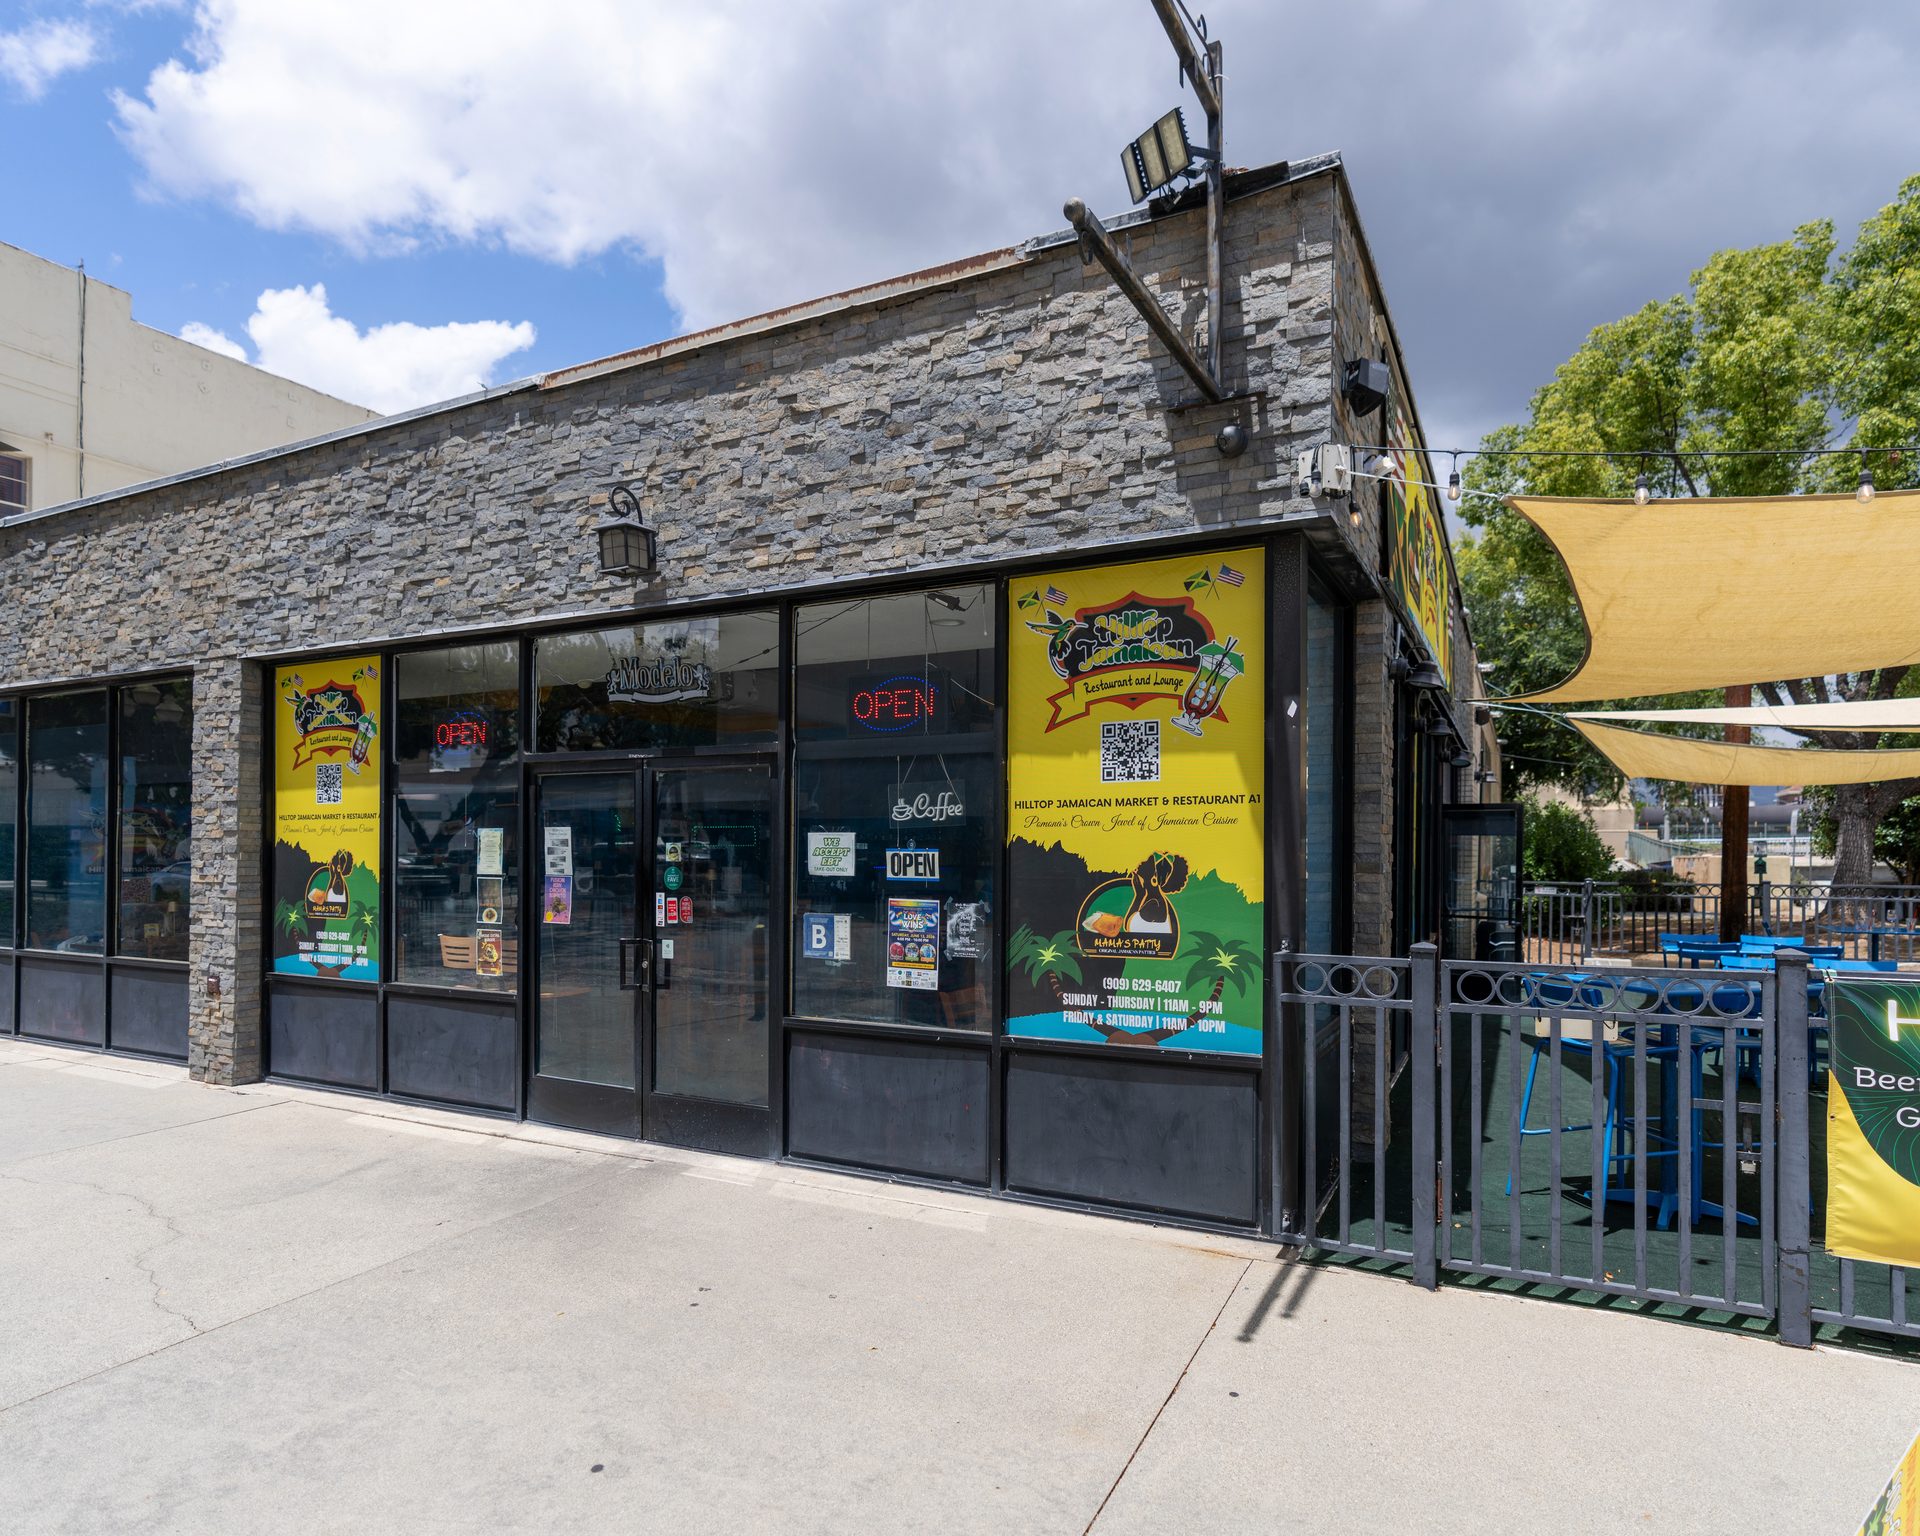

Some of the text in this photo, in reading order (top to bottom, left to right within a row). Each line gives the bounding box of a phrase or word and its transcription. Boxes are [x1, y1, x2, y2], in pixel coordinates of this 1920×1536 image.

[1094, 609, 1173, 645] Hilltop
[1076, 639, 1194, 672] Jamaican
[620, 656, 693, 690] Modelo
[1083, 671, 1184, 694] Restaurant and Lounge
[853, 688, 934, 719] OPEN
[437, 721, 486, 745] OPEN
[913, 791, 963, 821] Coffee
[1014, 794, 1261, 809] HILLTOP JAMAICAN MARKET & RESTAURANT A1
[1024, 811, 1238, 832] Pomona's Crown Jewel of Jamaican Cuisine
[812, 847, 851, 856] ACCEPT
[823, 837, 840, 846] WE
[820, 857, 842, 867] EBT
[890, 853, 936, 877] OPEN
[902, 920, 924, 929] WINS
[812, 924, 827, 949] B
[1094, 938, 1161, 951] MAMA'S PATTY
[1102, 977, 1182, 994] (909) 629-6407
[1062, 993, 1098, 1007] SUNDAY
[1107, 995, 1155, 1011] THURSDAY
[1163, 998, 1189, 1012] 11AM
[1199, 1000, 1223, 1015] 9PM
[1063, 1010, 1094, 1025] FRIDAY
[1096, 1013, 1104, 1025] &
[1105, 1012, 1153, 1029] SATURDAY
[1161, 1016, 1188, 1031] 11AM
[1198, 1019, 1226, 1034] 10PM
